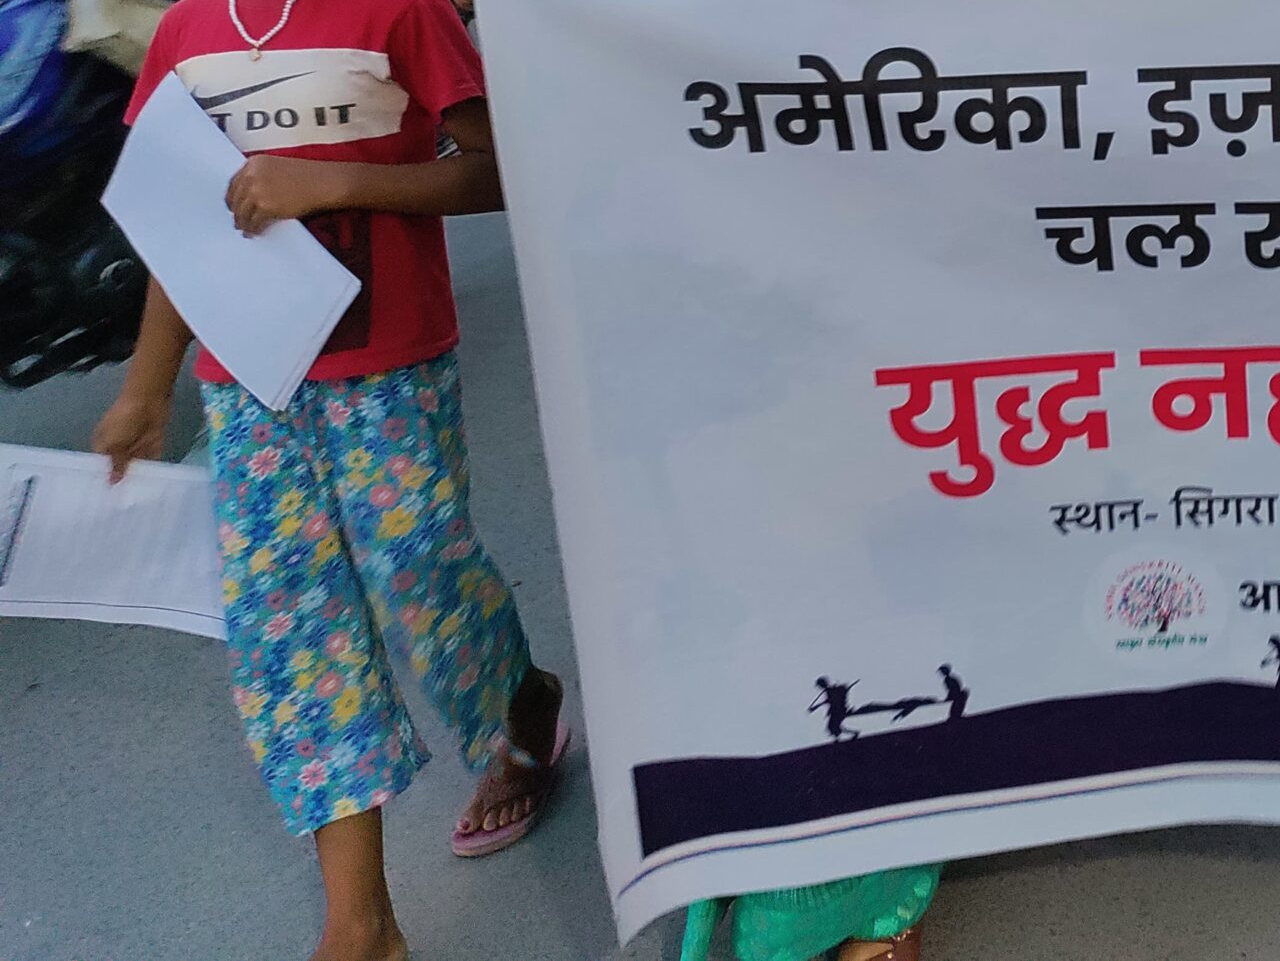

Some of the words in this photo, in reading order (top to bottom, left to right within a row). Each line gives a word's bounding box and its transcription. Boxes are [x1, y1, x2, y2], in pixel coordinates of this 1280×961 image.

[246, 107, 299, 131] DO
[313, 103, 357, 127] IT
[683, 46, 1116, 161] अमेरिका,
[1035, 202, 1216, 272] चल
[874, 351, 1116, 499] युद्ध
[1049, 497, 1158, 534] स्थान-
[1169, 486, 1278, 530] सिगरा
